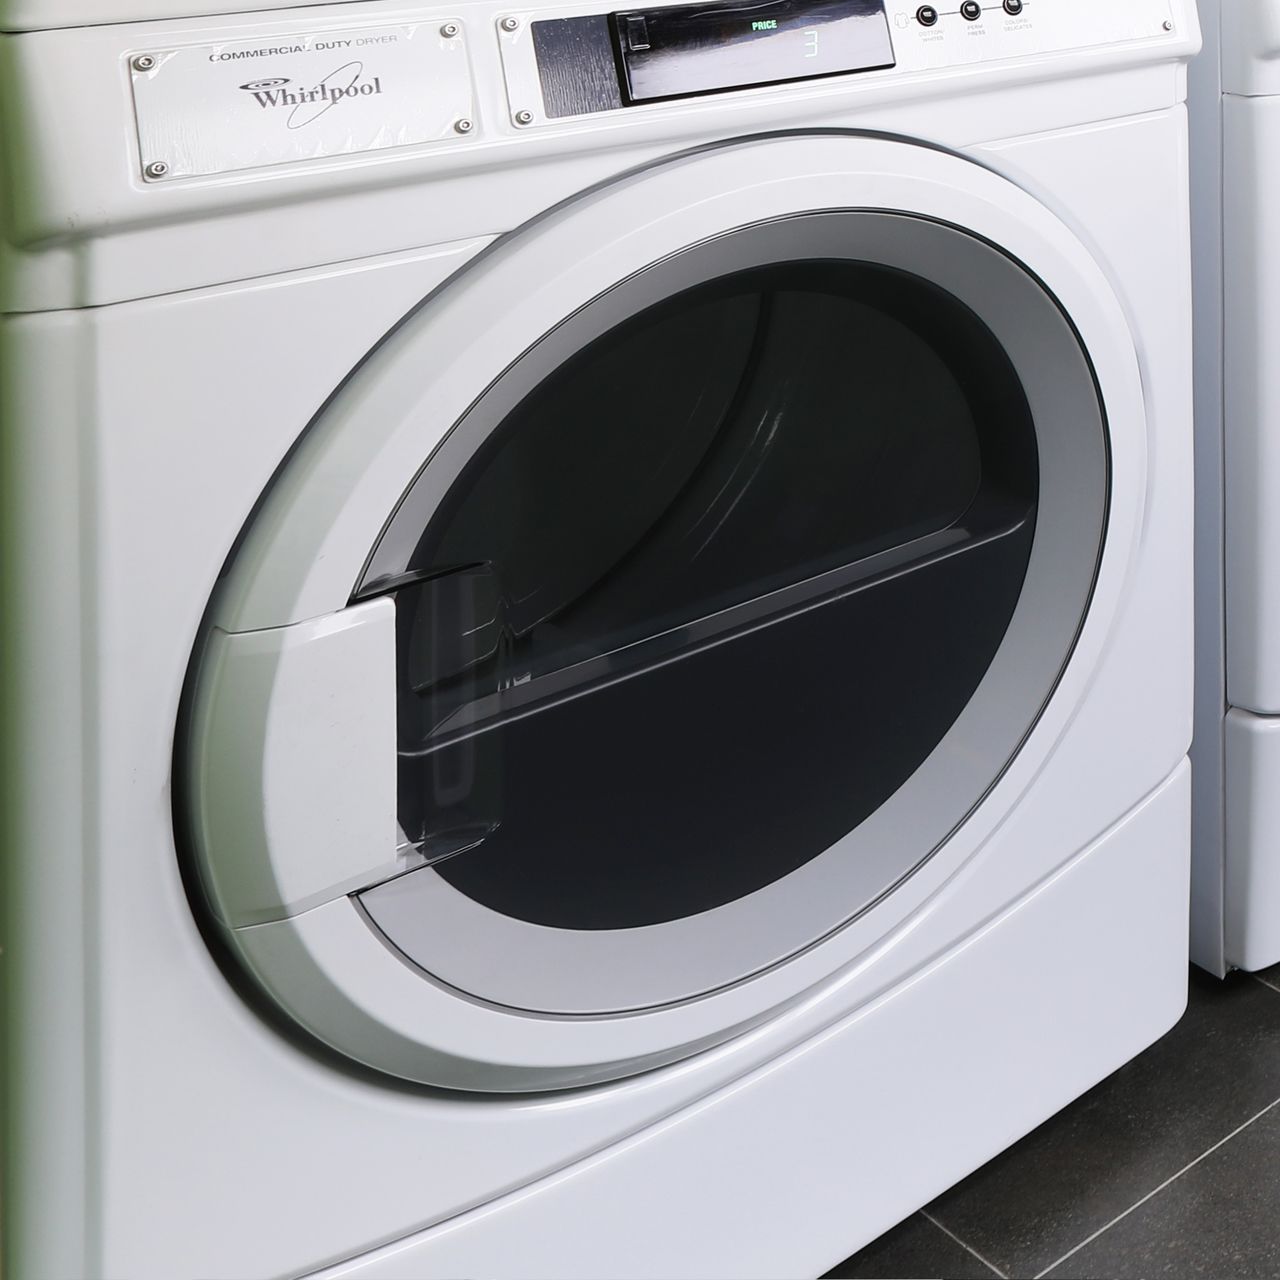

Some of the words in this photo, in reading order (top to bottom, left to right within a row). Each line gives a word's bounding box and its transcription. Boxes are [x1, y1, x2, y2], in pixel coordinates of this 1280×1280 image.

[752, 19, 778, 31] PRICE
[315, 39, 352, 52] DUTY
[355, 34, 398, 47] DRYER
[804, 30, 819, 58] 3
[250, 76, 383, 110] Whirlpool
